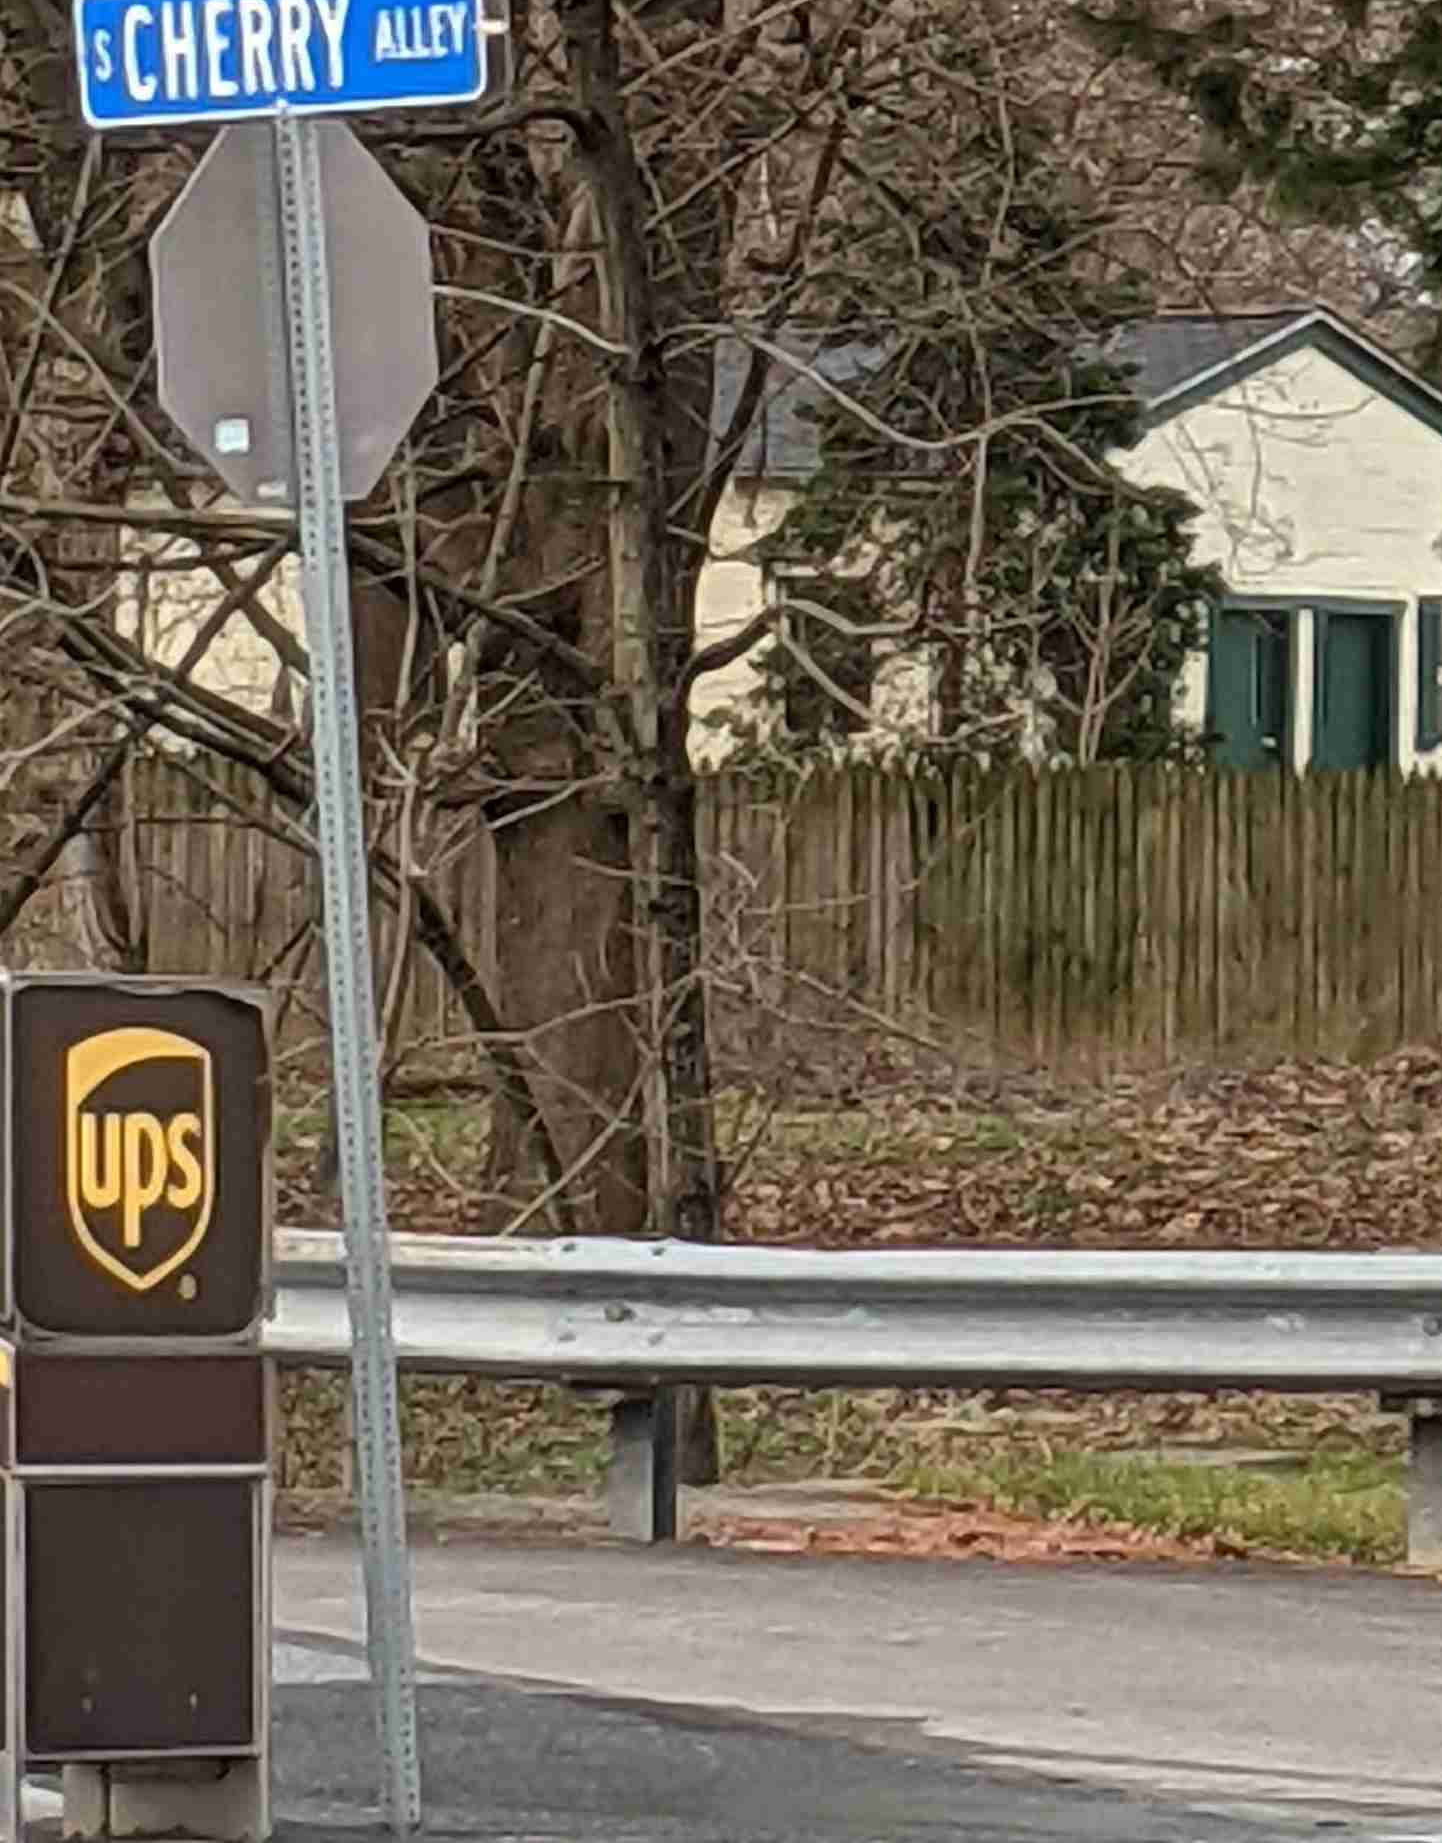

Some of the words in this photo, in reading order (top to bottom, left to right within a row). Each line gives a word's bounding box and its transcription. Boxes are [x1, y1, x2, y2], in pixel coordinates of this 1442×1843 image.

[93, 29, 113, 82] S
[374, 0, 468, 62] ALLEY
[81, 1112, 201, 1248] ups
